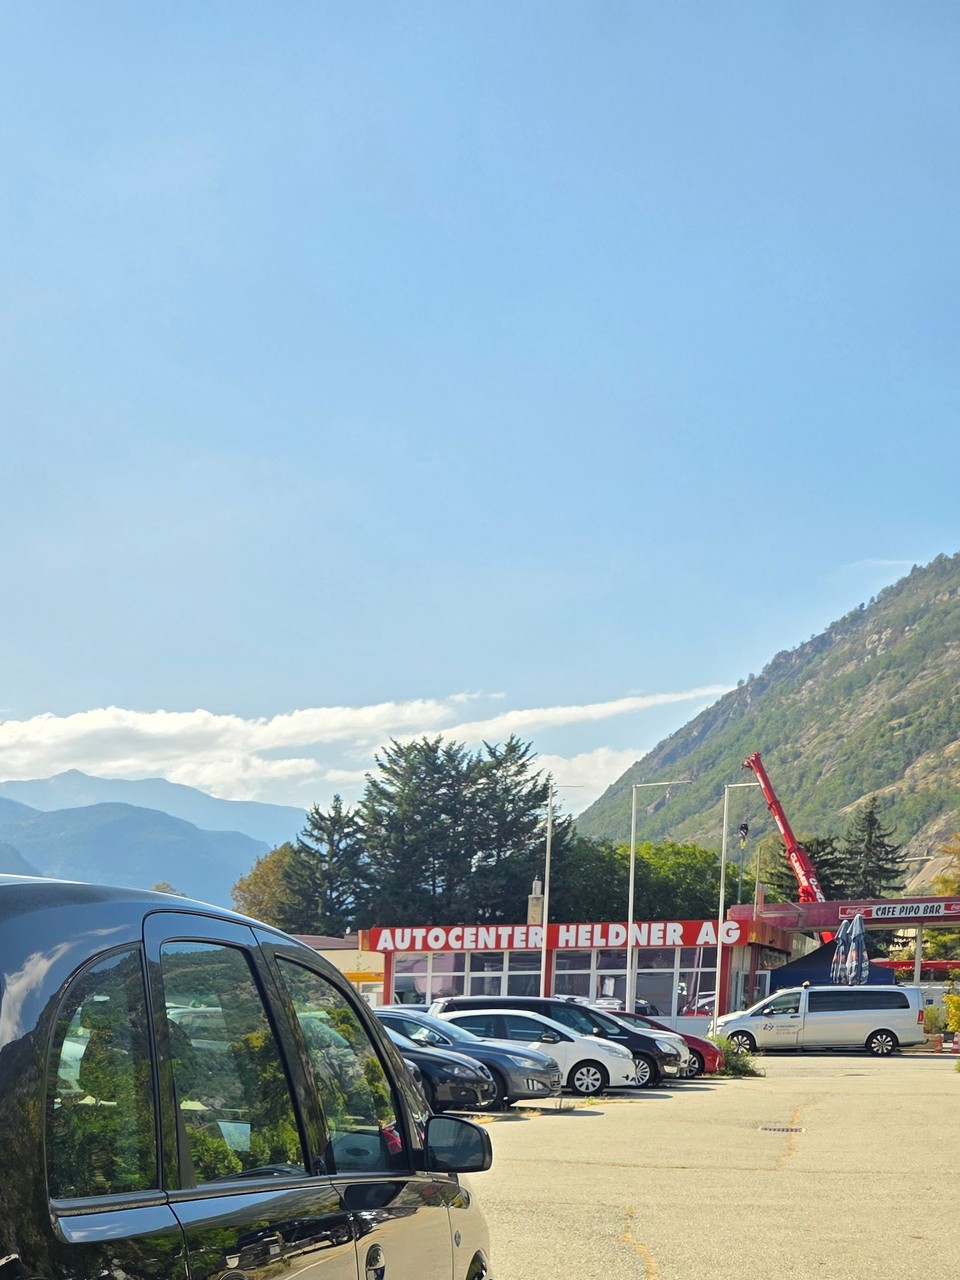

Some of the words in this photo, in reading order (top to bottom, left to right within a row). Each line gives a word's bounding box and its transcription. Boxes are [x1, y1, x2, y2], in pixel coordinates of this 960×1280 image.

[875, 906, 897, 917] CAFE
[899, 905, 920, 916] PIPO
[922, 904, 942, 915] BAR
[376, 926, 544, 950] AUTOCENTER
[557, 922, 684, 948] HELDNER
[695, 920, 741, 945] AG
